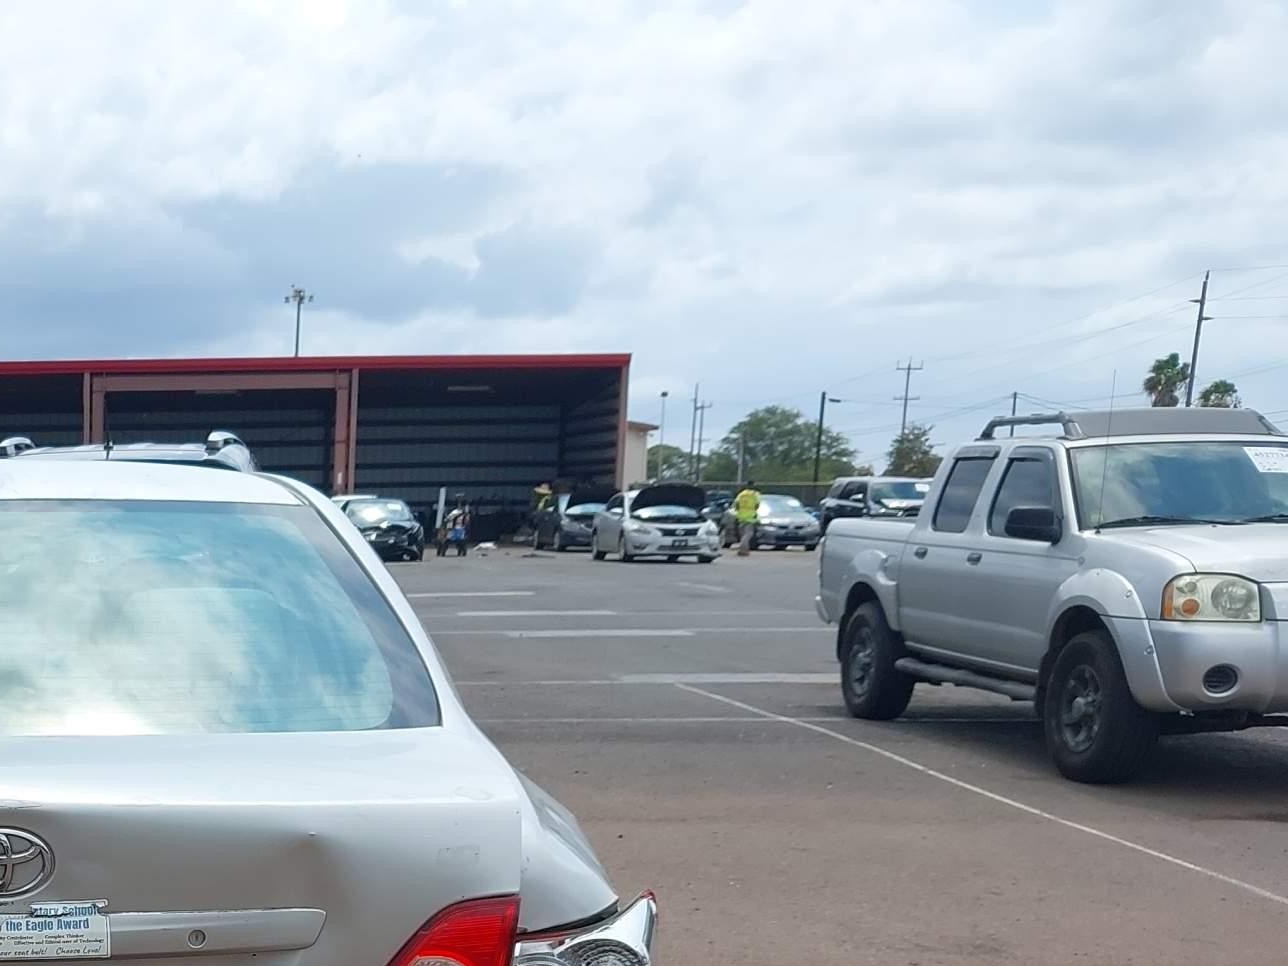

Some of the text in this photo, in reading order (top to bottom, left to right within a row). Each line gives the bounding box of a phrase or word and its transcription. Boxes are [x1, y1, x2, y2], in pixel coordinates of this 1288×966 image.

[62, 904, 97, 917] School
[6, 920, 22, 932] the
[25, 920, 53, 933] Eagle
[57, 918, 89, 931] Award
